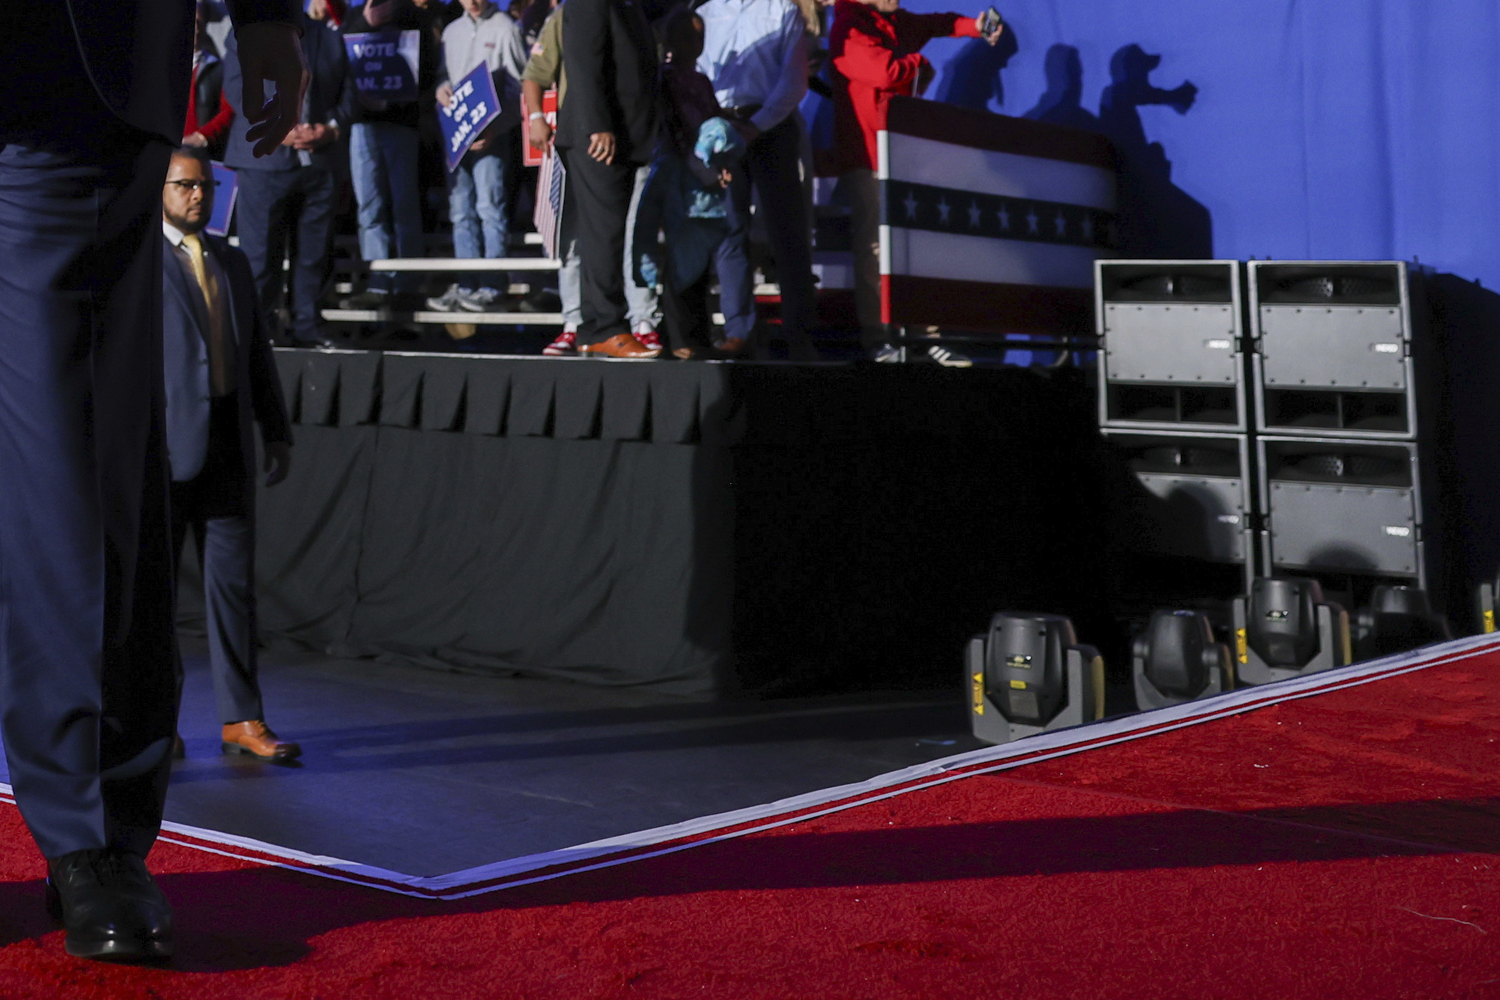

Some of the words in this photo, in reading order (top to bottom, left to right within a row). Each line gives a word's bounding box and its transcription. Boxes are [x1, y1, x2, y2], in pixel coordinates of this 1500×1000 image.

[352, 43, 396, 59] VOTE
[383, 75, 403, 90] 23
[469, 101, 487, 125] 23
